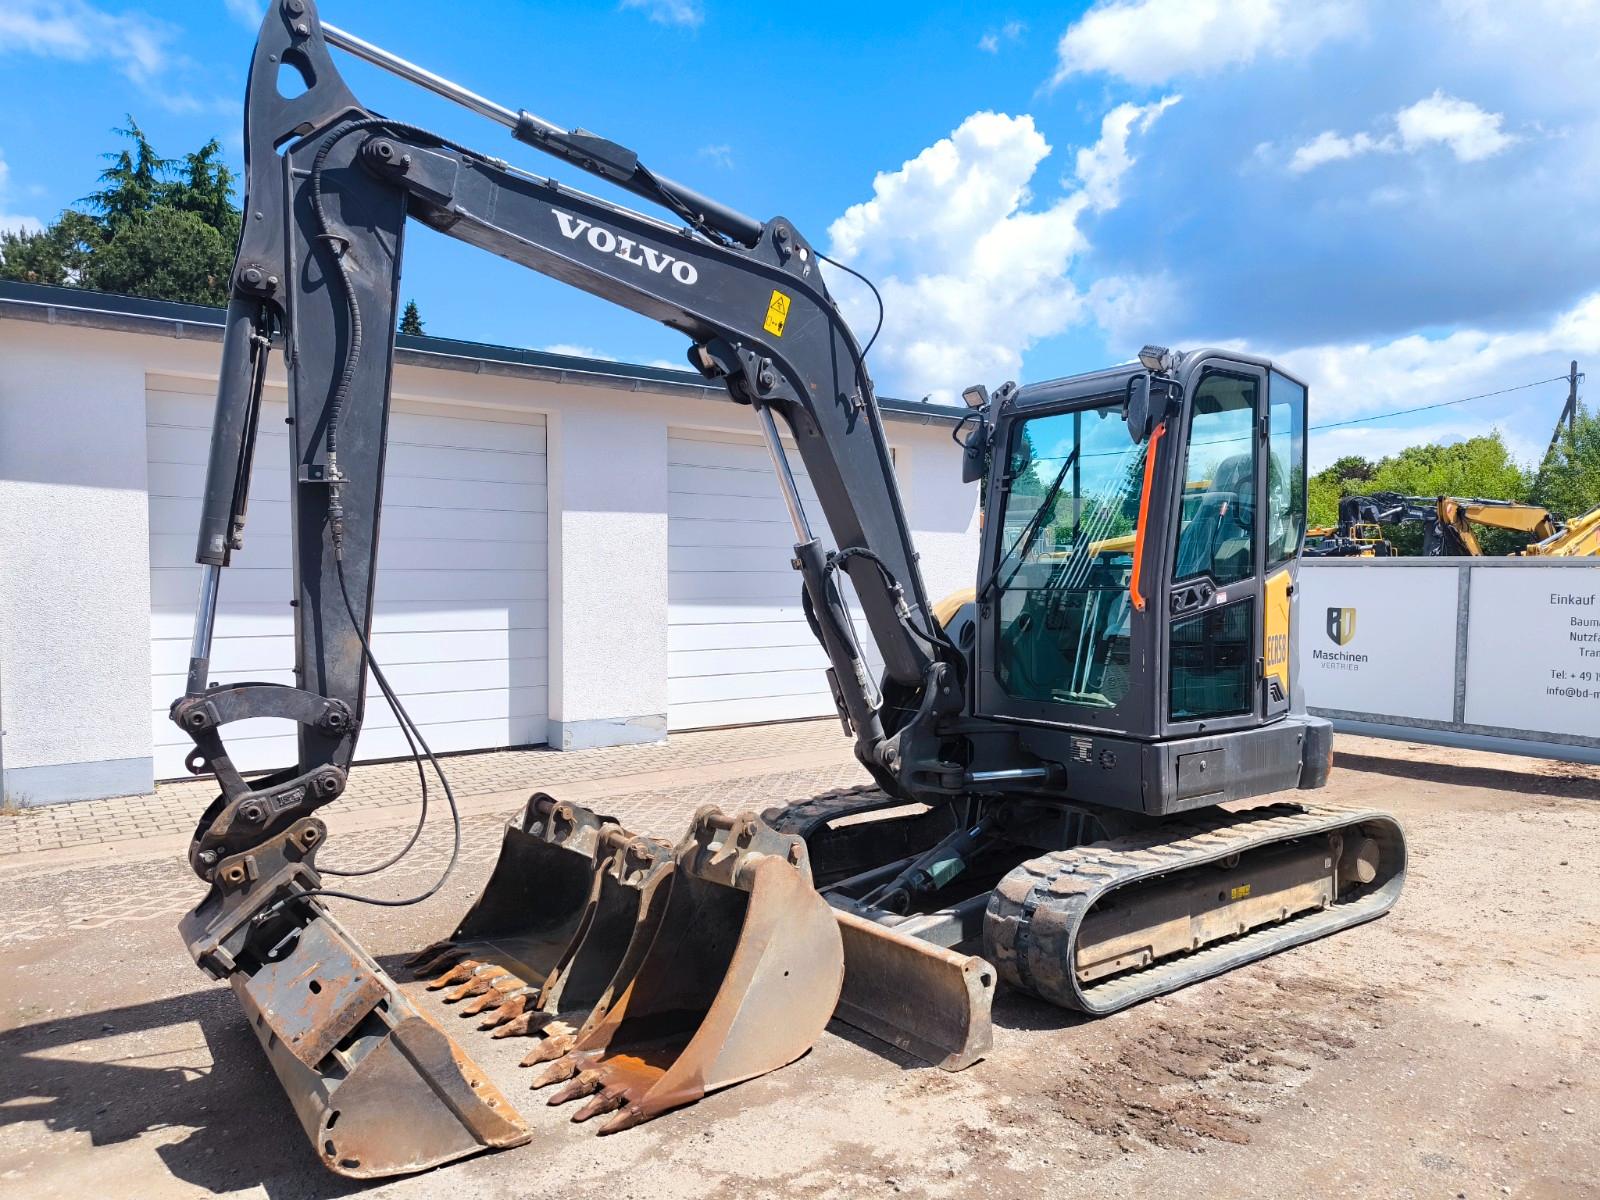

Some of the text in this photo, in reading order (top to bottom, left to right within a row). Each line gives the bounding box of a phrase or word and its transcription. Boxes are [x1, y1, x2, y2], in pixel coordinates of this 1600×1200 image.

[551, 208, 699, 286] VOLVO
[1550, 593, 1596, 606] Einkauf
[1570, 616, 1600, 627] Baum
[1312, 649, 1369, 663] Maschinen
[1320, 662, 1360, 671] VERTRIEB
[1551, 669, 1567, 680] Tel:
[1579, 671, 1592, 681] 49
